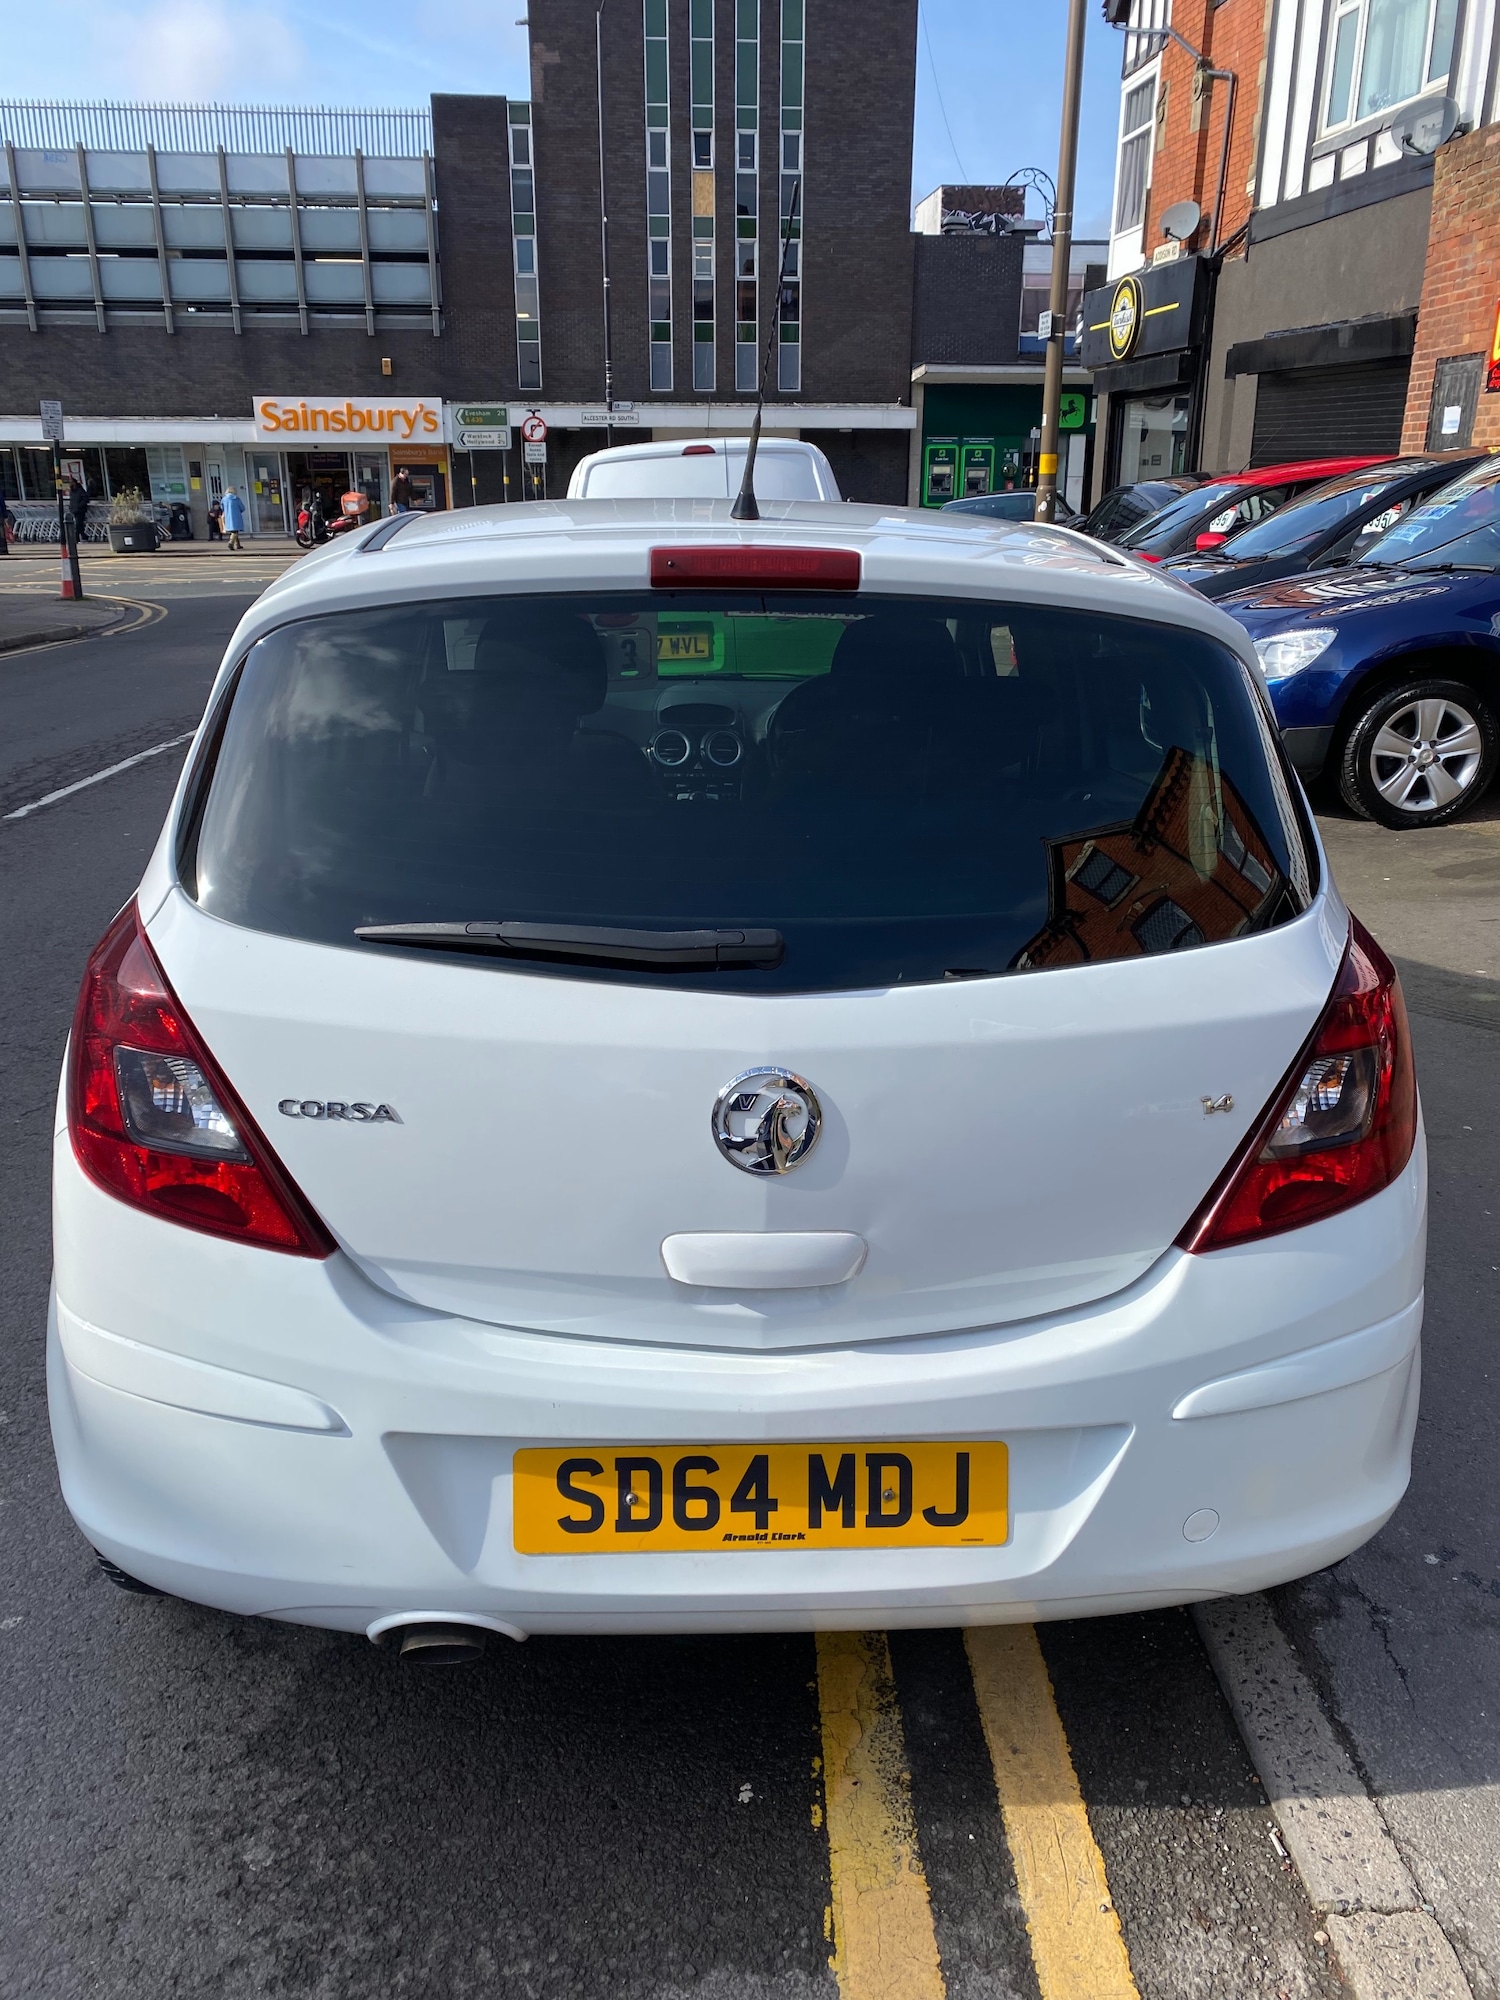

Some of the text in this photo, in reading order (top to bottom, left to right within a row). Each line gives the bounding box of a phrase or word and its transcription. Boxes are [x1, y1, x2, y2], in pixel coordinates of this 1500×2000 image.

[260, 401, 438, 438] Sainsbury's
[669, 636, 705, 655] WVL
[278, 1099, 400, 1122] CORSA
[556, 1452, 970, 1534] SD64 MDJ
[722, 1533, 769, 1542] Arnold
[771, 1532, 807, 1540] Clark
